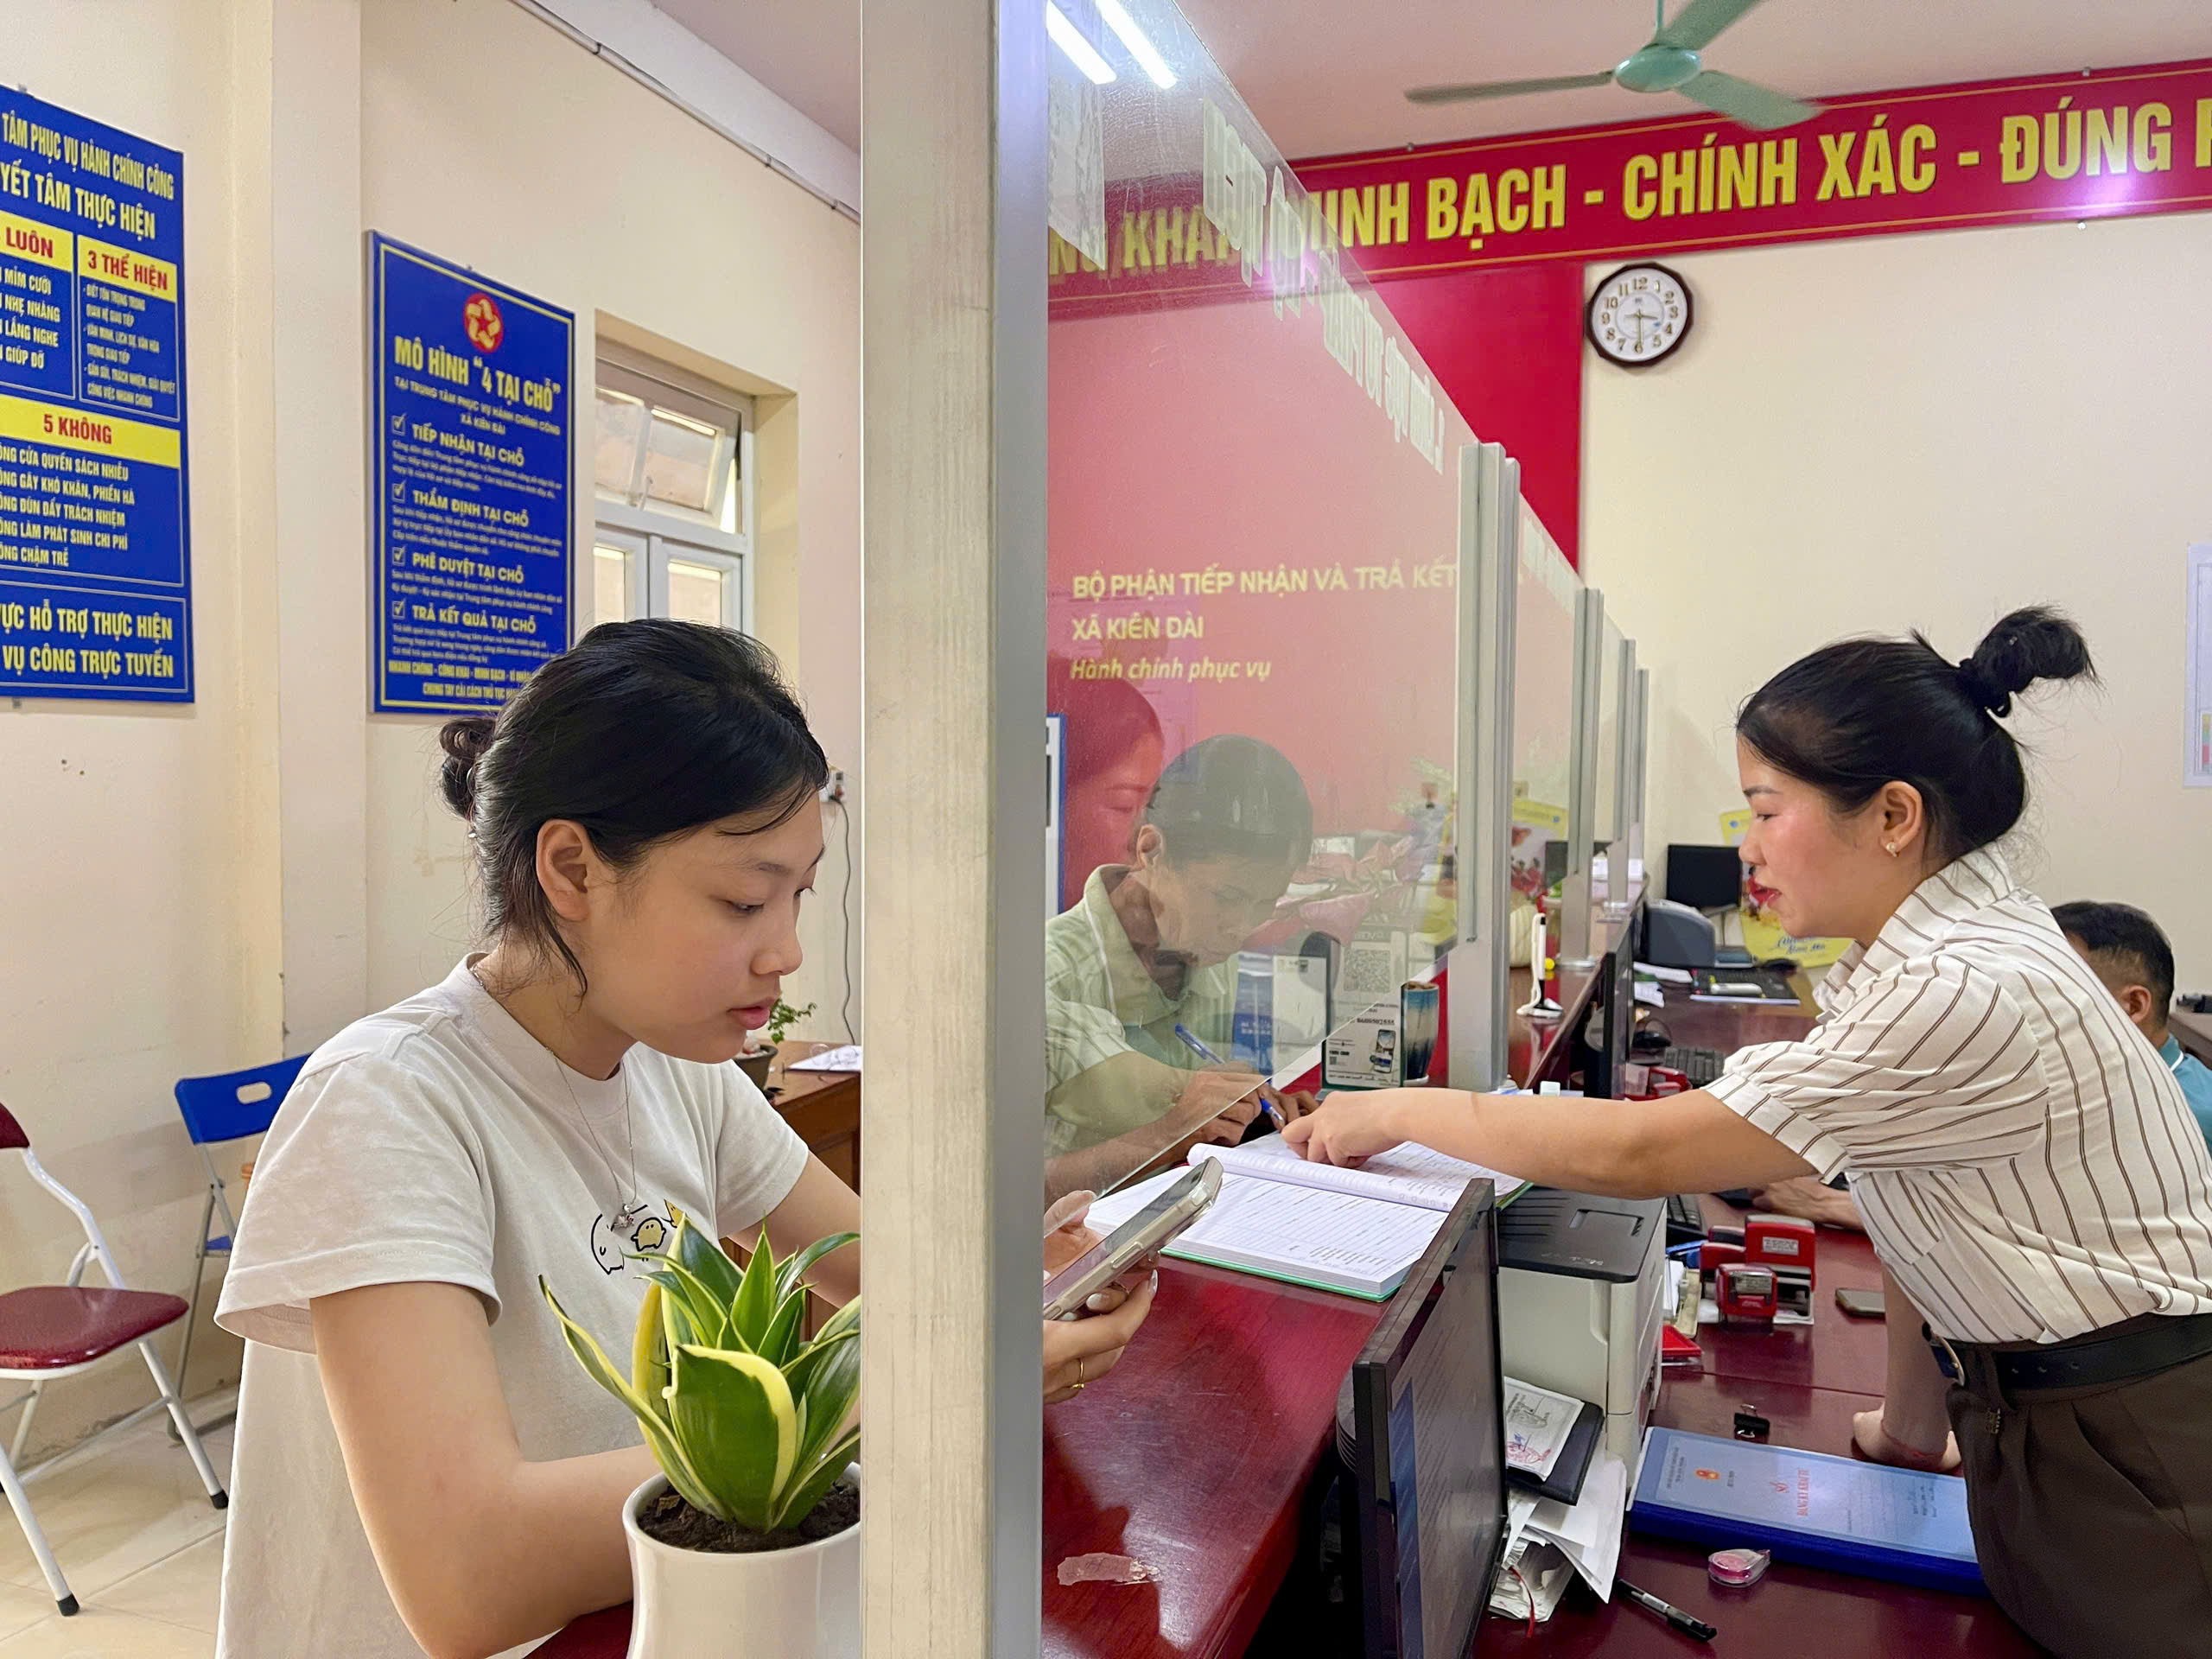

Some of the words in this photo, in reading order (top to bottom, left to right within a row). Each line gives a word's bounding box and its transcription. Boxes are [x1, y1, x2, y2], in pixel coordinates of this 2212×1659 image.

[2, 110, 28, 149] TÂM
[30, 123, 61, 164] PHỤC
[64, 135, 79, 172] VỤ
[81, 138, 111, 178] HÀNH
[113, 153, 144, 190] CHÍNH
[147, 163, 175, 200] CÔNG
[1427, 165, 1567, 250] BẠCH
[1623, 133, 1798, 221] CHÍNH
[1817, 114, 1937, 202] XÁC
[1999, 96, 2172, 184] ĐÚNG
[35, 172, 71, 213] TÂM
[75, 188, 116, 229] THỰC
[120, 203, 156, 241] HIỆN
[6, 226, 54, 258] LUÔN
[88, 250, 98, 270] 3
[101, 253, 129, 279] THỂ
[134, 264, 168, 291] HIỆN
[1632, 276, 1648, 290] 12
[1618, 283, 1629, 296] 11
[1654, 280, 1660, 292] 1
[1665, 291, 1674, 304] 2
[1604, 296, 1618, 308] 10
[1669, 306, 1678, 319] 3
[1601, 312, 1611, 325] 9
[1665, 322, 1673, 335] 4
[1605, 327, 1615, 340] 8
[1618, 338, 1625, 352] 7
[1653, 334, 1662, 347] 5
[395, 335, 423, 371] MÔ
[429, 346, 468, 385] HÌNH
[495, 370, 519, 405] TẠI
[43, 414, 54, 433] 5
[58, 417, 112, 444] KHÔNG
[412, 422, 437, 444] TIẾP
[440, 433, 475, 455] NHẬN
[478, 442, 495, 461] TẠI
[499, 447, 524, 467] CHỖ
[75, 456, 99, 476] SÁCH
[413, 486, 448, 509] THẨM
[451, 499, 480, 518] ĐỊNH
[483, 507, 500, 525] TẠI
[503, 509, 529, 528] CHỖ
[70, 529, 93, 546] SINH
[95, 532, 111, 549] CHI
[412, 551, 435, 569] PHÊ
[439, 556, 475, 580] DUYỆT
[478, 564, 495, 582] TẠI
[498, 564, 524, 584] CHỖ
[1072, 569, 1105, 601] BỘ
[1111, 569, 1175, 601] PHẬN
[1180, 563, 1236, 595] TIẾP
[1240, 564, 1307, 598] NHẬN
[1313, 562, 1348, 592] VÀ
[1354, 558, 1405, 590] TRẢ
[1413, 555, 1457, 588] KẾT
[0, 602, 25, 634] ỰC
[29, 599, 52, 632] HỖ
[57, 607, 88, 639] TRỢ
[92, 611, 132, 642] THỰC
[137, 612, 173, 645] HIỆN
[412, 603, 435, 622] TRẢ
[439, 605, 460, 624] KẾT
[462, 609, 488, 628] QUẢ
[491, 615, 508, 634] TẠI
[511, 614, 537, 633] CHỖ
[1071, 613, 1101, 641] XÃ
[1107, 612, 1160, 640] KIÊN
[3, 645, 25, 676] VỤ
[30, 642, 76, 673] CÔNG
[79, 649, 121, 680] TRỰC
[125, 647, 175, 678] TUYẾN
[1071, 658, 1122, 680] Hành
[1128, 657, 1183, 679] chính
[1188, 655, 1239, 683] phục
[1246, 659, 1271, 682] vụ
